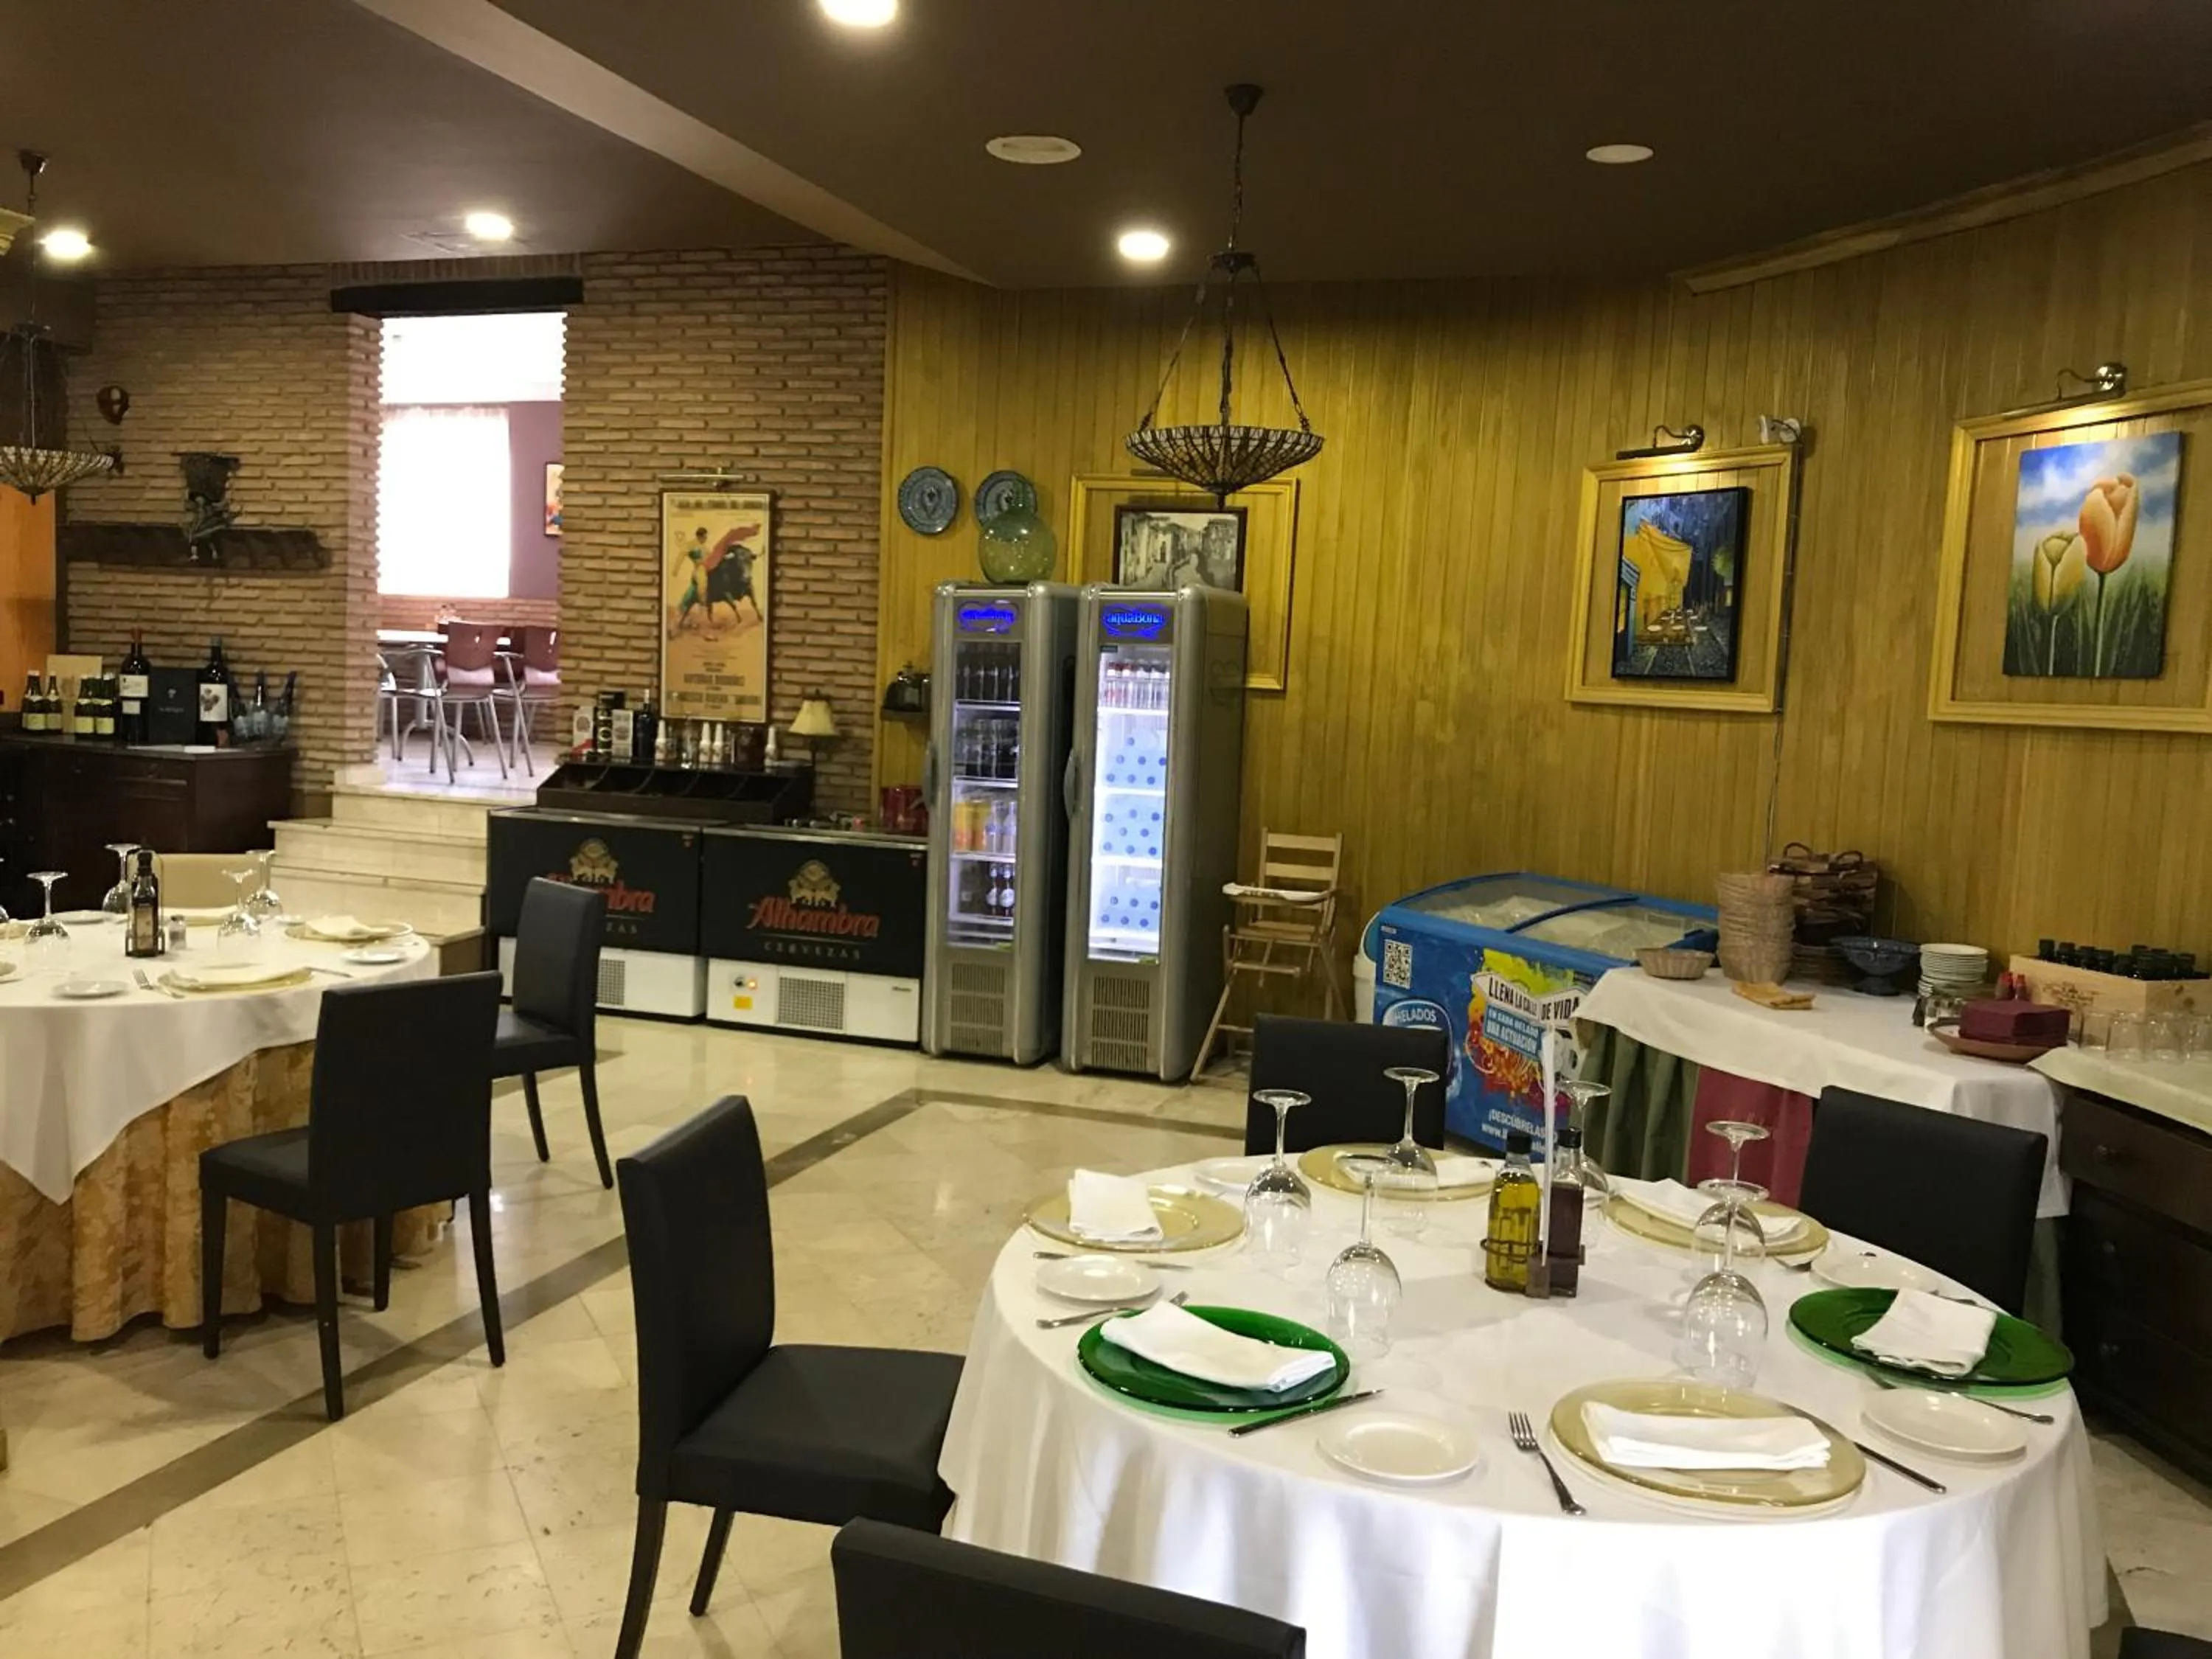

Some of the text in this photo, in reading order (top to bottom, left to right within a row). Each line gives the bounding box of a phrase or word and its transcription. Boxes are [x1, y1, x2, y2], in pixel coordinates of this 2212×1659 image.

[745, 895, 881, 939] Alhambra
[763, 941, 861, 961] CERVEZAS
[1488, 976, 1514, 1007] LLENA
[1541, 1002, 1551, 1021] DE
[1394, 1007, 1437, 1023] HELADOS
